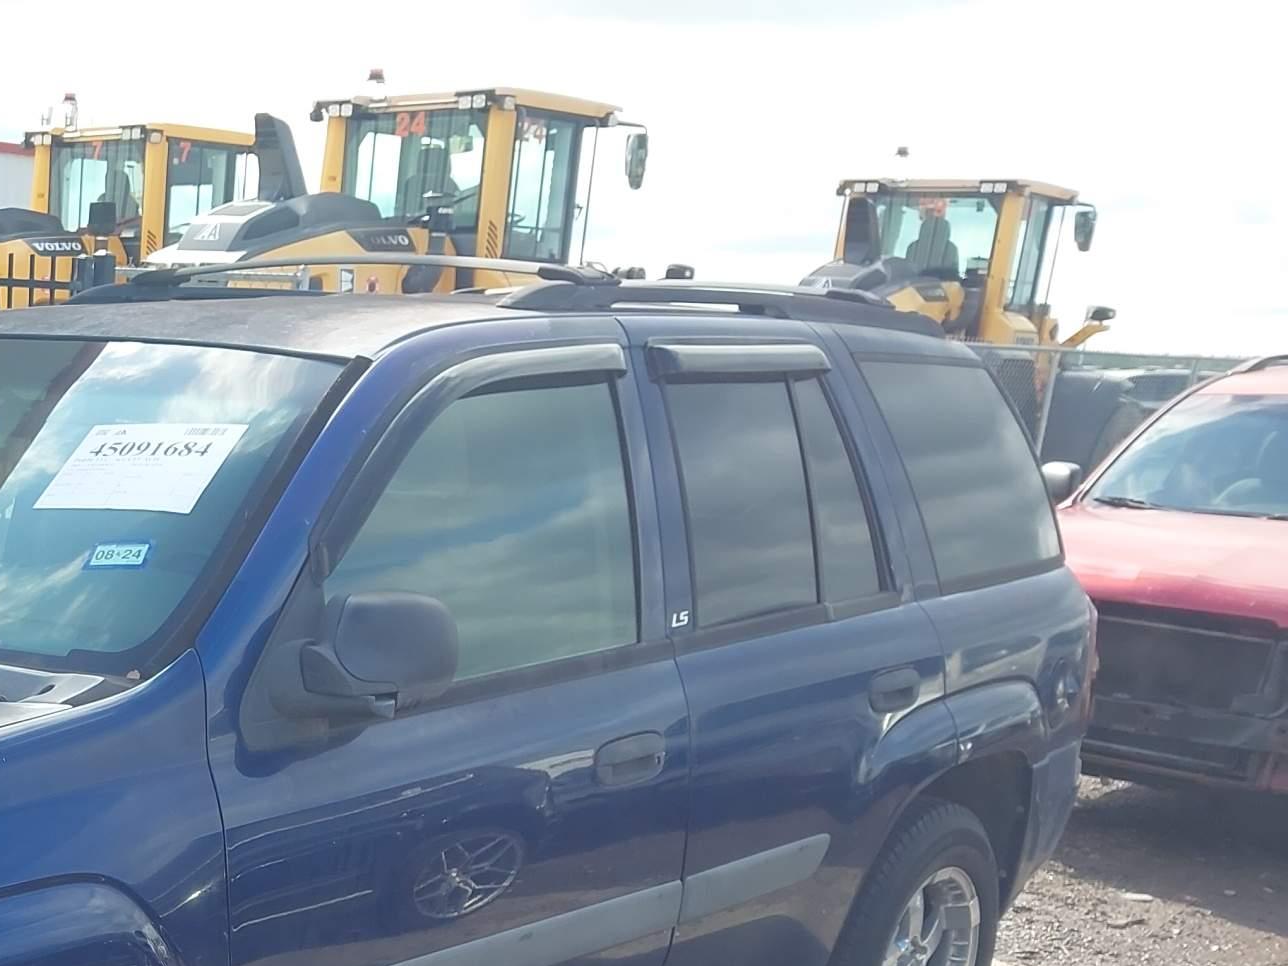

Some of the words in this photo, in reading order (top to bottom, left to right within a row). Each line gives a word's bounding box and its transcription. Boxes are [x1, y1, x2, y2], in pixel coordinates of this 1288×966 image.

[395, 112, 426, 138] 24
[92, 142, 104, 160] 7
[179, 142, 192, 163] 7
[32, 242, 82, 251] VOLVO
[368, 235, 410, 246] OLVO
[89, 441, 214, 457] 45091684
[671, 610, 689, 628] LS
